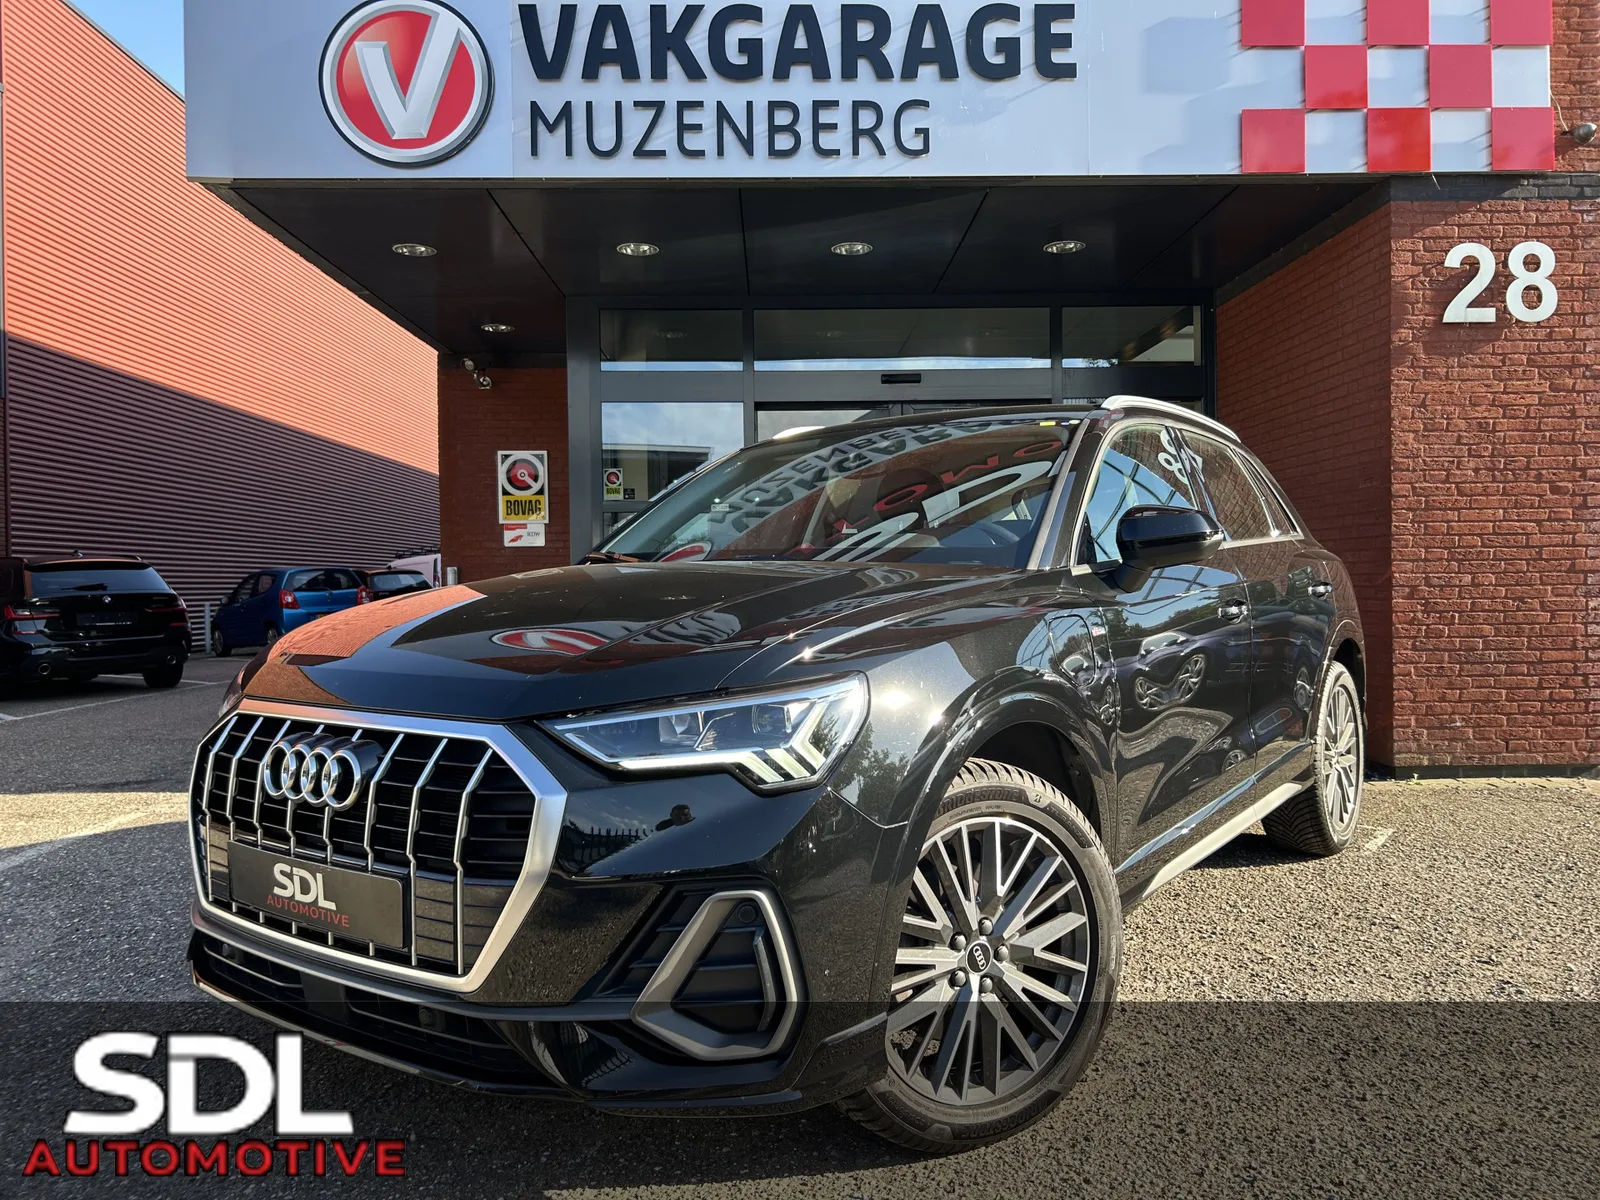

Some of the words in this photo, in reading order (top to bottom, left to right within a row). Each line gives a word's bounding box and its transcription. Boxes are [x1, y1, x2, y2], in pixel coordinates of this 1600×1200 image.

[519, 3, 1077, 81] VAKGARAGE
[530, 98, 932, 158] MUZENBERG
[1442, 241, 1558, 323] 28
[505, 499, 542, 516] BOVAG
[267, 893, 350, 928] AUTOMOTIVE
[273, 862, 337, 910] SDL
